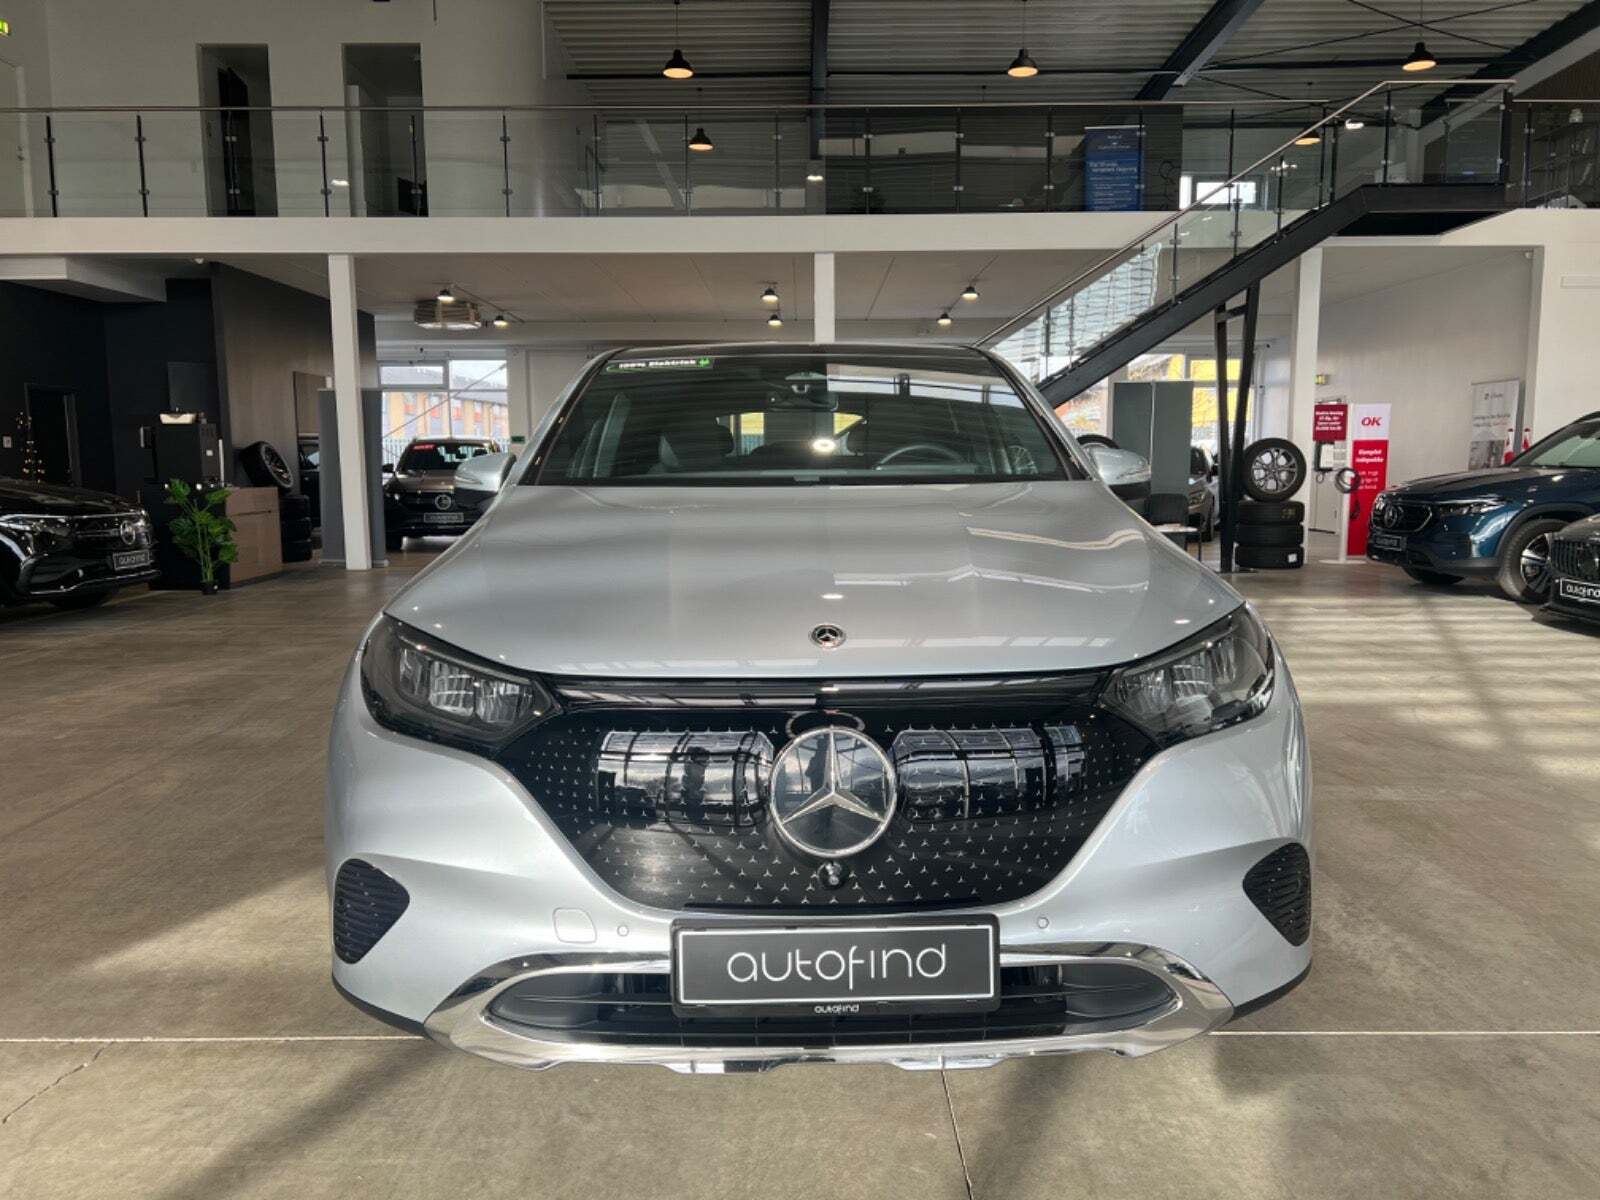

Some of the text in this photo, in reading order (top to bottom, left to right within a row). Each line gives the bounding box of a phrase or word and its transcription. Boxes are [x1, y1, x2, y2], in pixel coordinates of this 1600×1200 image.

[1361, 416, 1382, 427] OK
[726, 943, 947, 990] autofind
[814, 1003, 860, 1014] autofind
